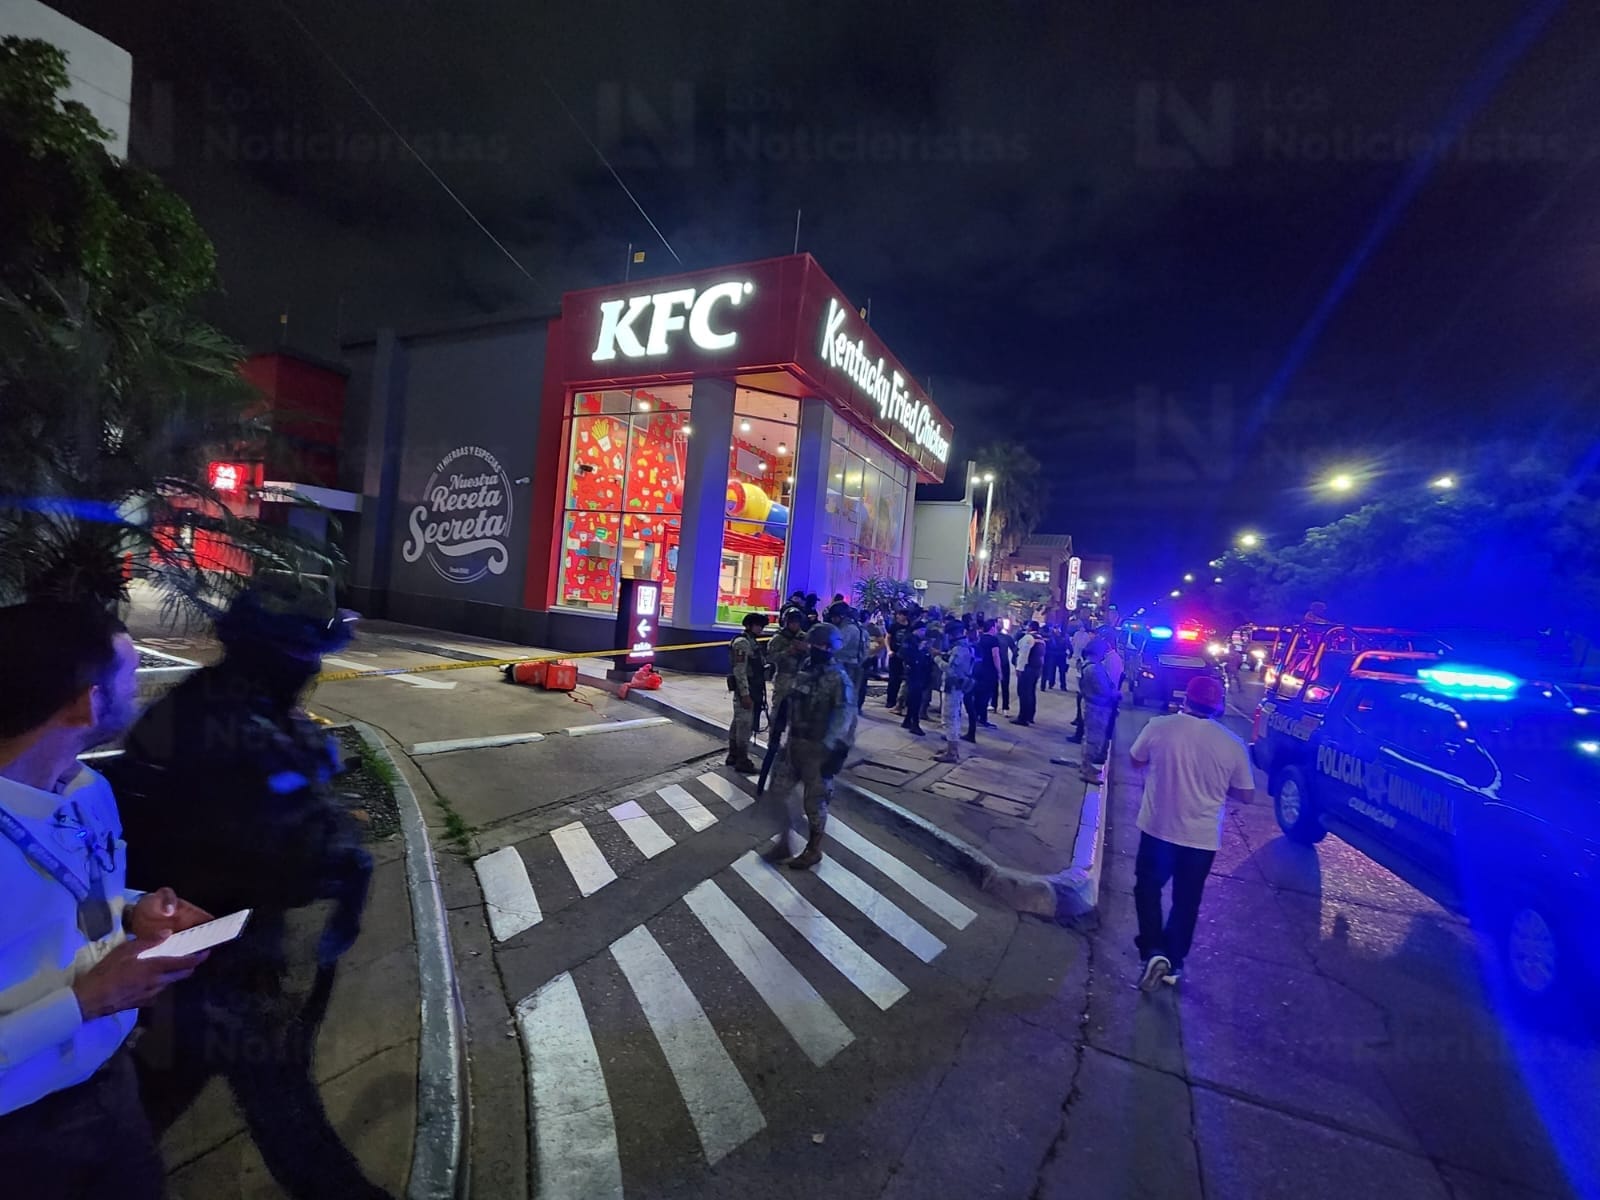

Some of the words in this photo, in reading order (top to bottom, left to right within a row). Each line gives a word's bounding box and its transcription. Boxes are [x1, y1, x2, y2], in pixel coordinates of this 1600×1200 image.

[591, 281, 744, 362] KFC
[821, 298, 892, 419] Kentucky
[887, 370, 921, 435] Fried
[915, 404, 949, 463] Chicken
[431, 485, 502, 512] Receta
[450, 473, 499, 490] Nuestra
[403, 505, 506, 562] Secreta
[1316, 744, 1363, 789] POLICIA
